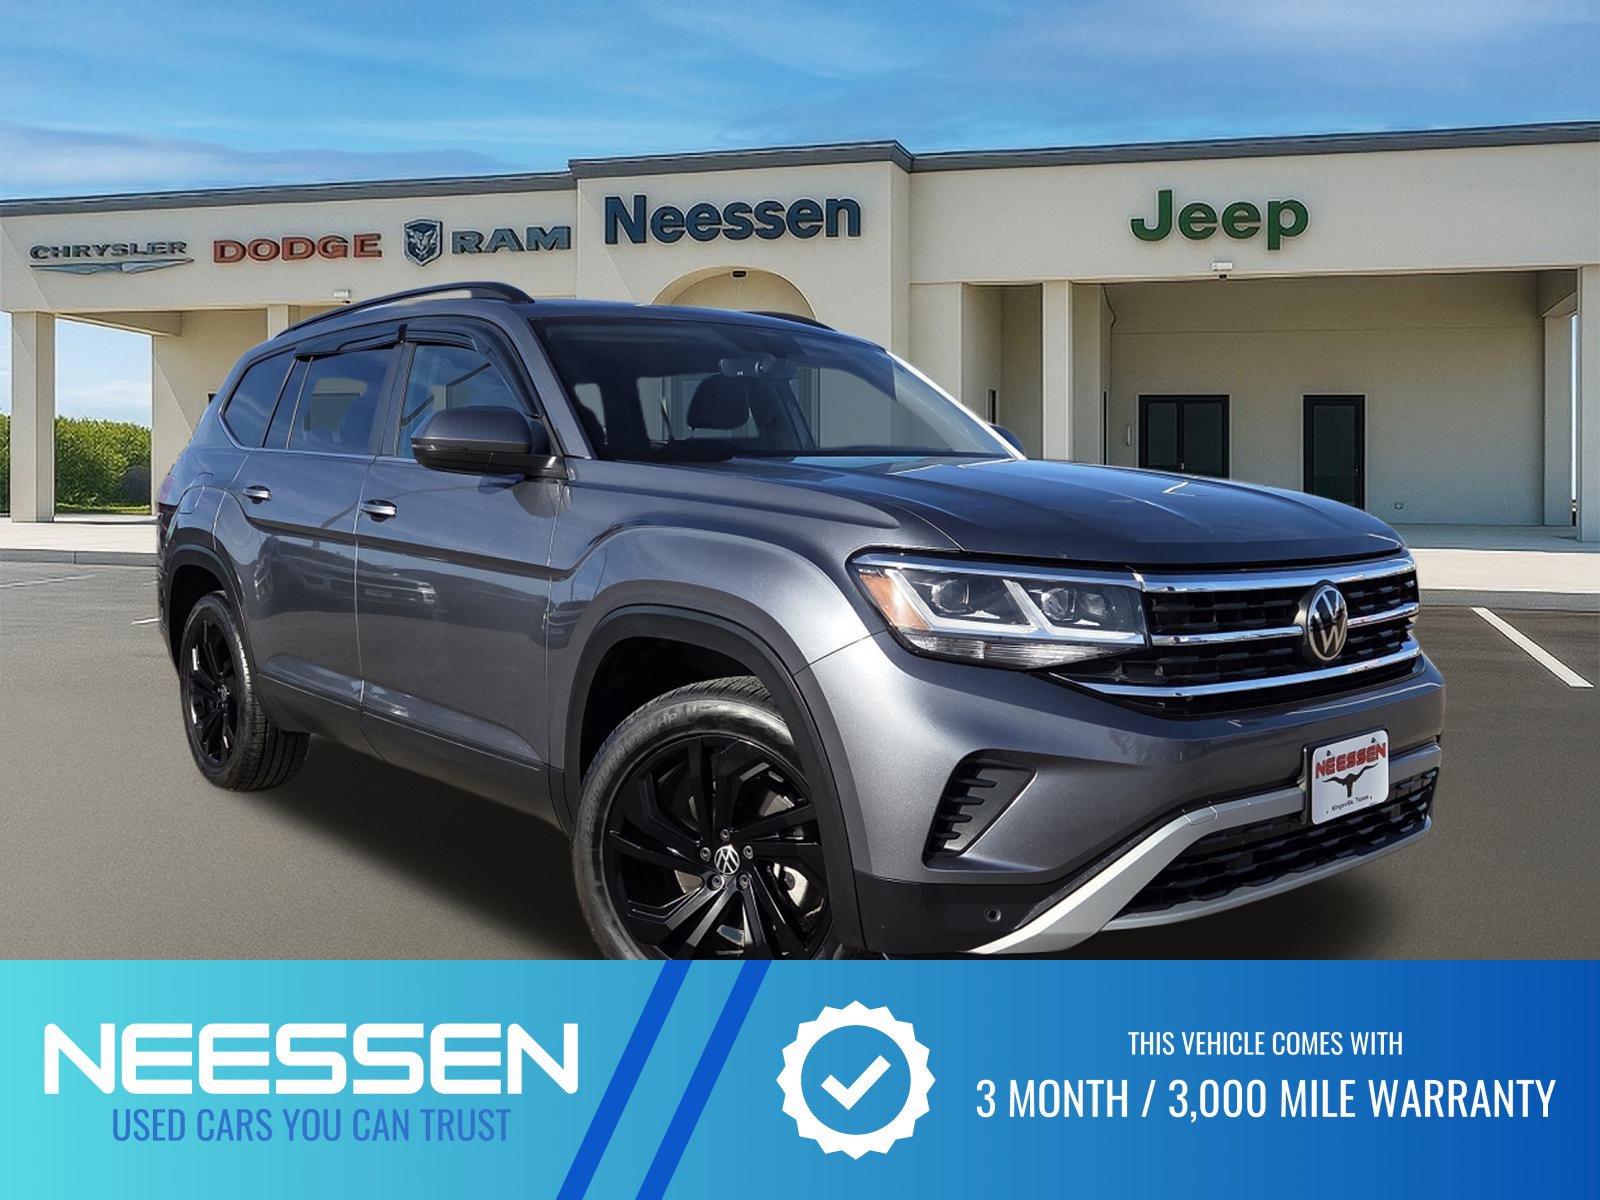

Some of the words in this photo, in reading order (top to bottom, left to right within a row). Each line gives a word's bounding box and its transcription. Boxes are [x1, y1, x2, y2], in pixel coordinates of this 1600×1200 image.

[604, 194, 863, 245] Neessen
[1130, 189, 1310, 250] Jeep
[30, 241, 187, 259] CHRYSLER
[213, 233, 383, 264] DODGE
[452, 226, 571, 254] RAM
[1315, 743, 1387, 779] NEESSEN
